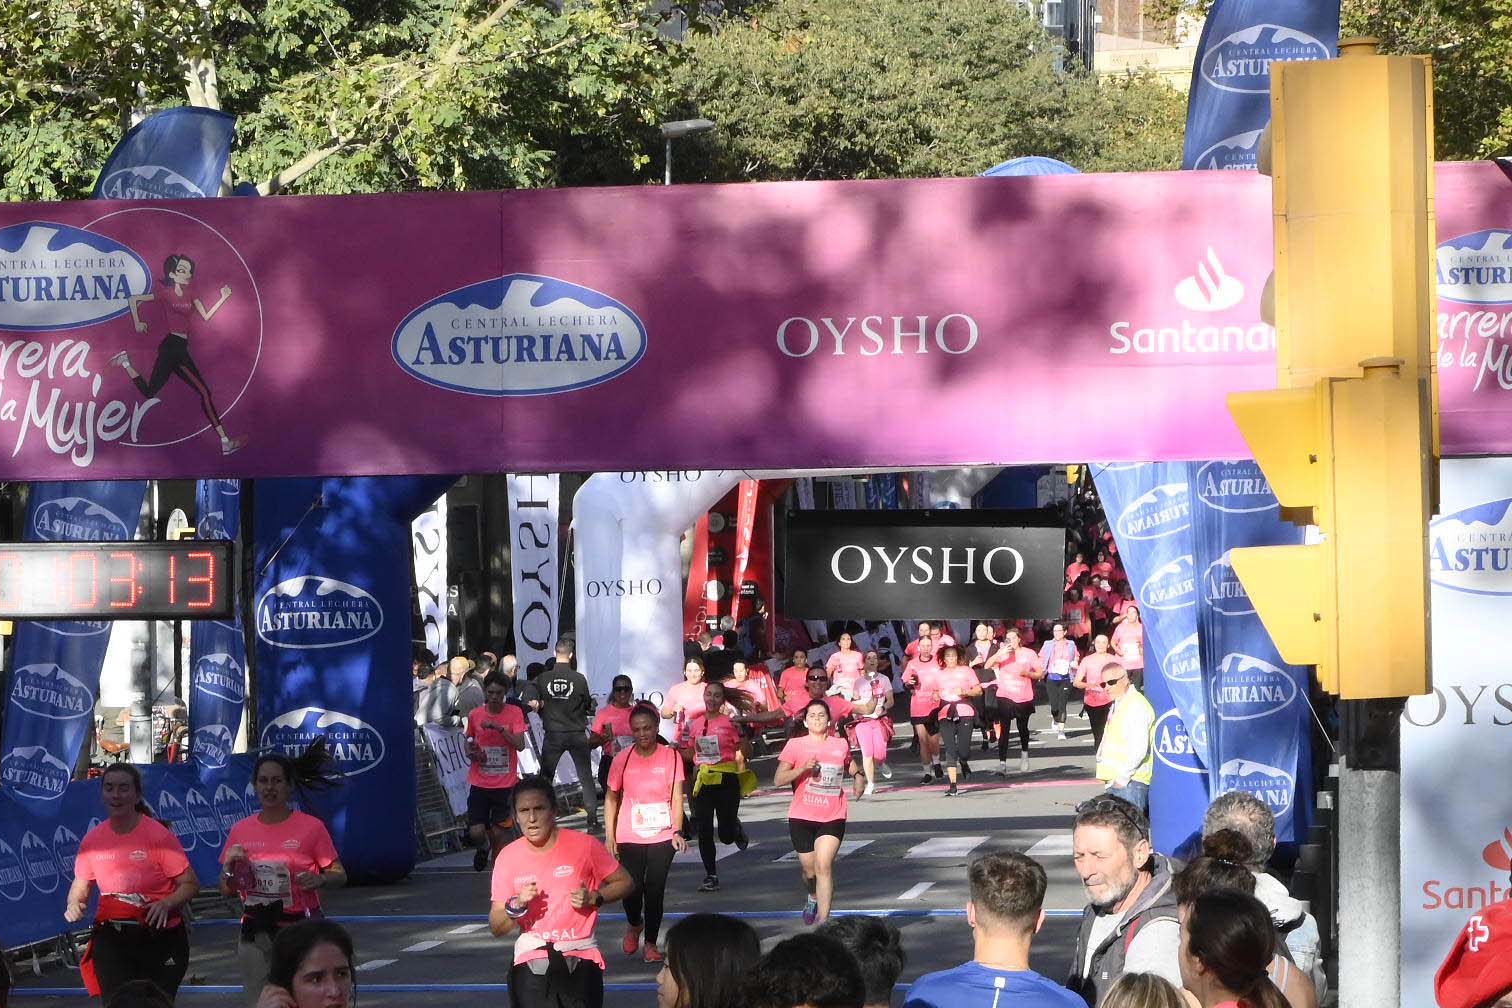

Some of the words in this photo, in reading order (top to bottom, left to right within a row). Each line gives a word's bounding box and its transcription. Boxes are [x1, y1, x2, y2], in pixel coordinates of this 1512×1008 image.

[53, 256, 126, 269] LECHERA
[450, 315, 529, 330] CENTRAL
[538, 314, 618, 328] LECHERA
[777, 313, 979, 358] OYSHO
[412, 321, 627, 366] ASTURIANA
[1110, 320, 1276, 354] Santand
[1460, 340, 1477, 367] la
[12, 375, 161, 468] Mujer
[1203, 472, 1272, 497] ASTURIA
[831, 545, 1025, 586] OYSHO
[587, 578, 662, 598] OYSHO
[261, 605, 374, 633] ASTURIANA
